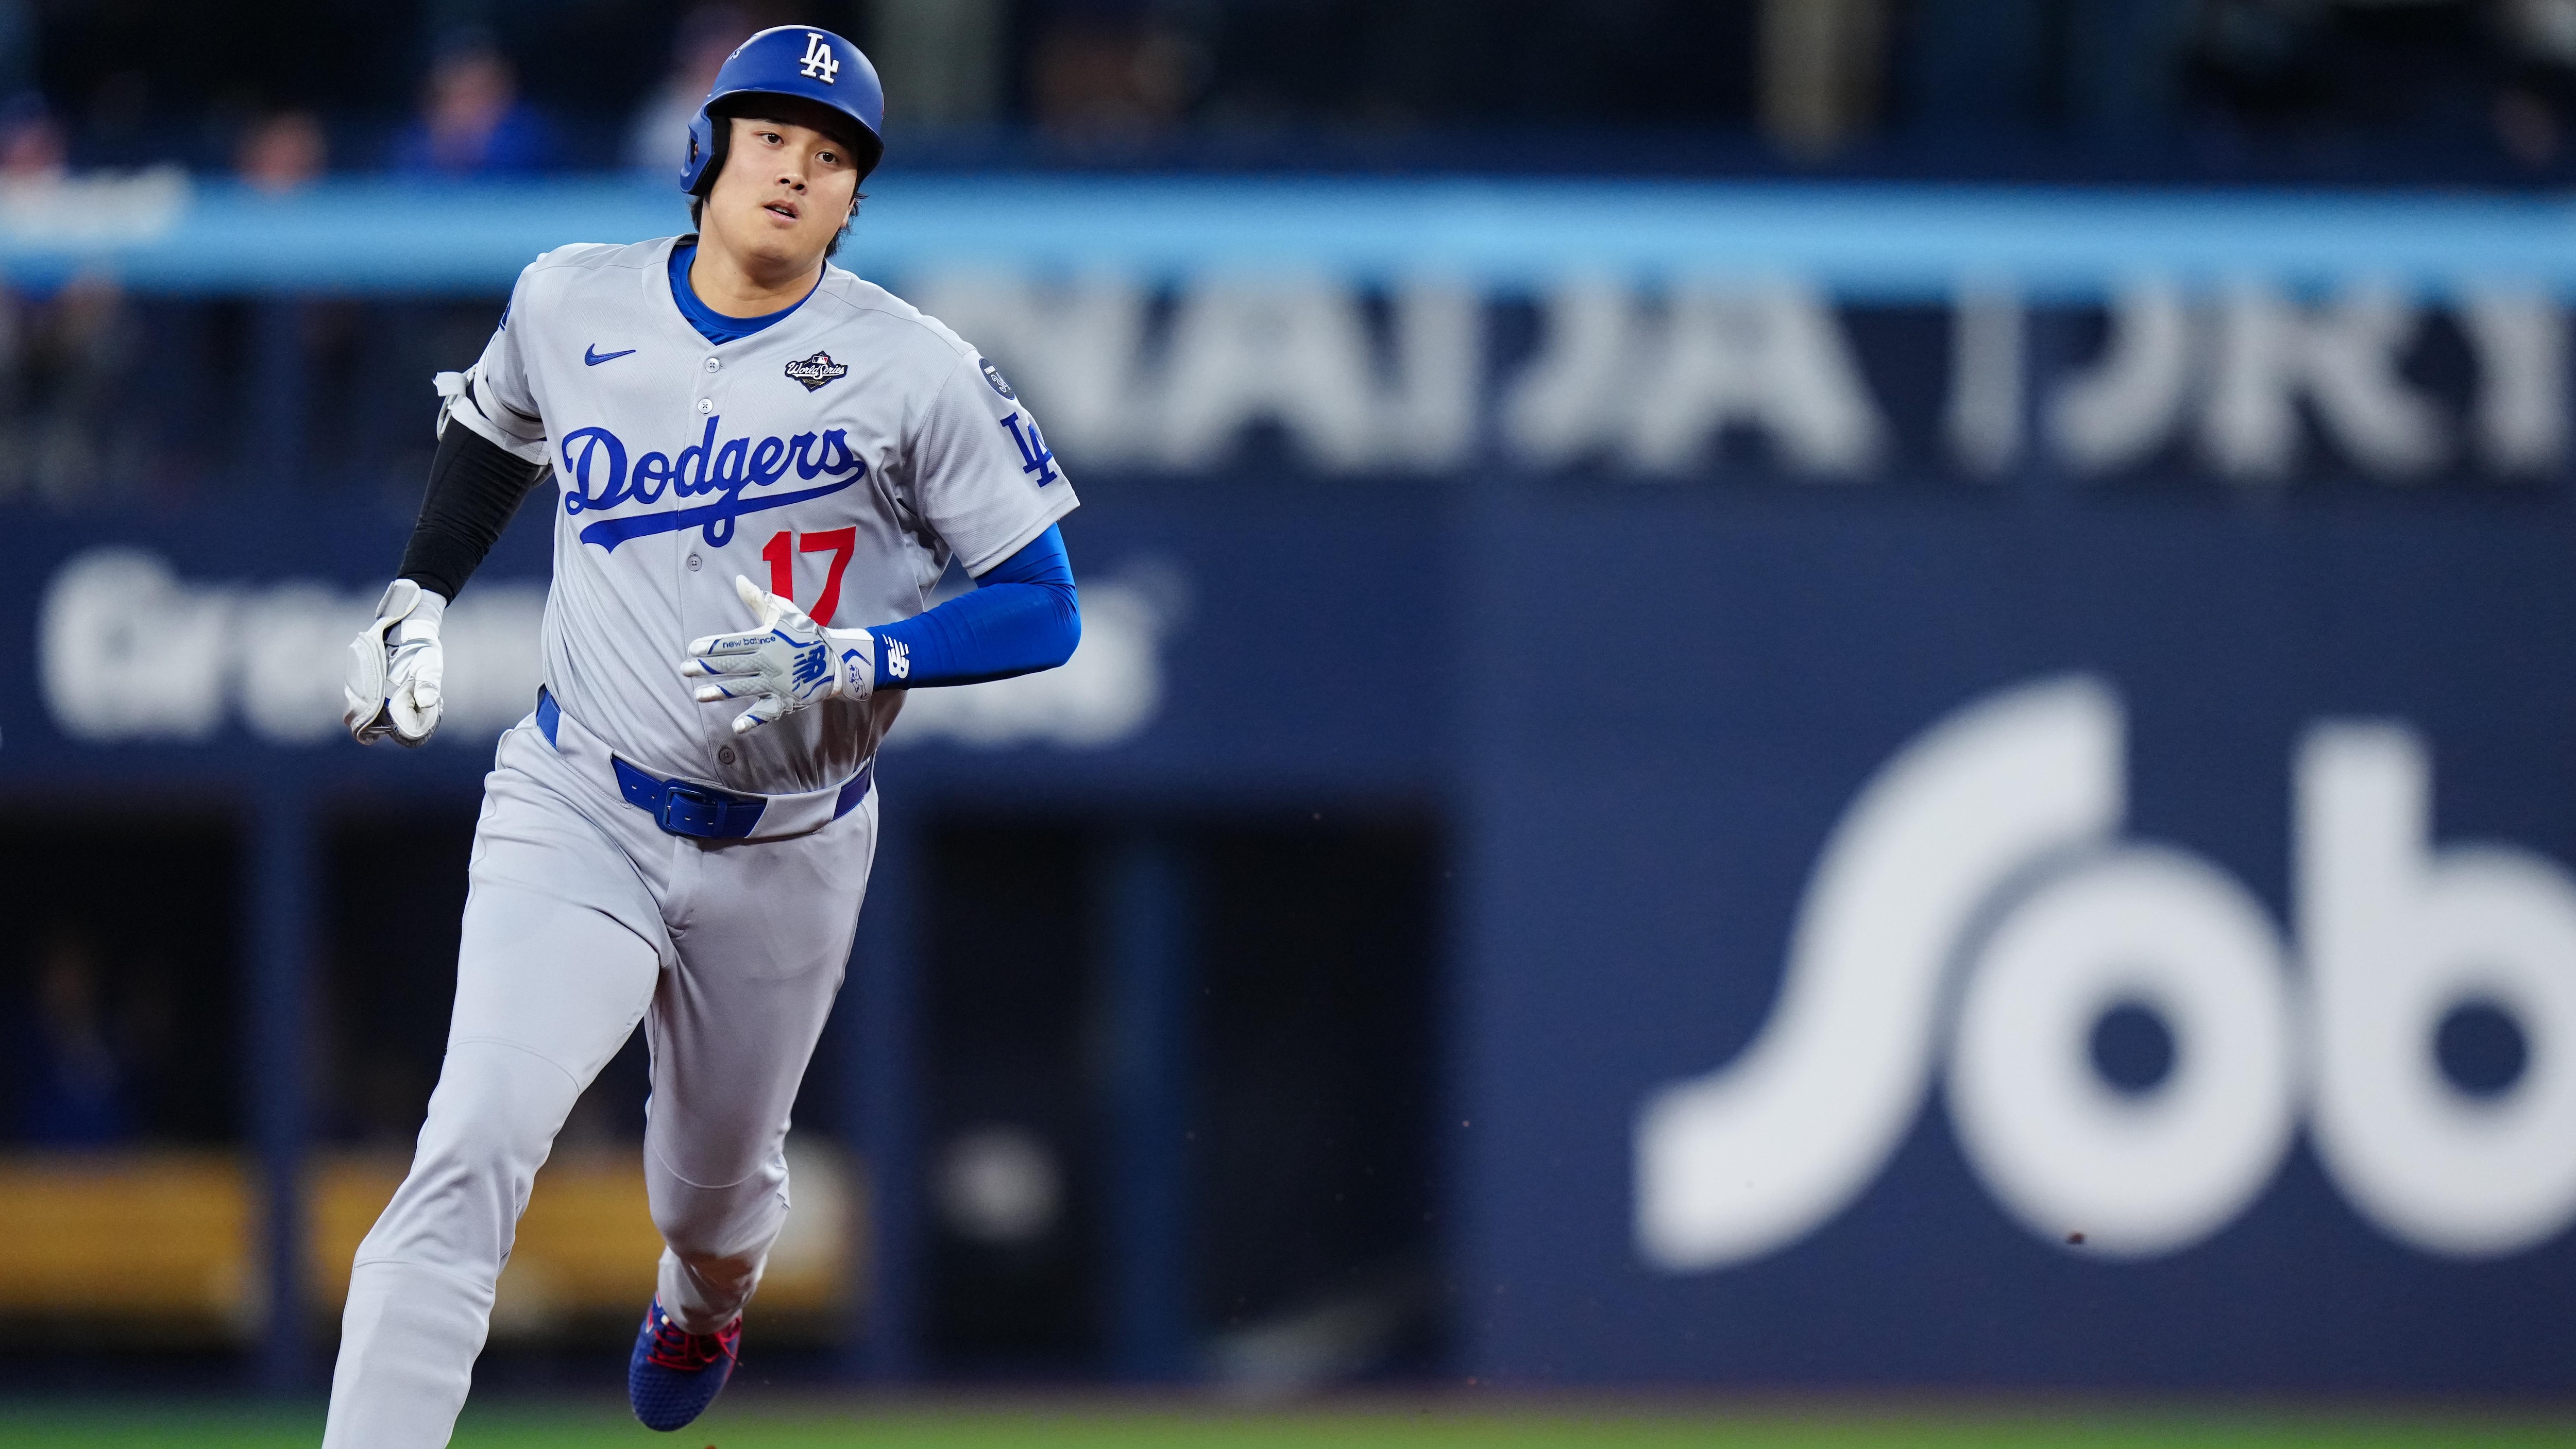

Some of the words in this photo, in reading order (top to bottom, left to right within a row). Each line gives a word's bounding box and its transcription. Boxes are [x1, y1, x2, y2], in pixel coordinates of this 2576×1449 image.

[800, 32, 839, 84] LA
[787, 363, 821, 375] World
[814, 364, 844, 379] Series
[562, 415, 867, 548] Dodgers
[999, 412, 1058, 487] LA
[762, 526, 856, 627] 17
[723, 640, 741, 649] new
[1631, 670, 2576, 1275] Sob
